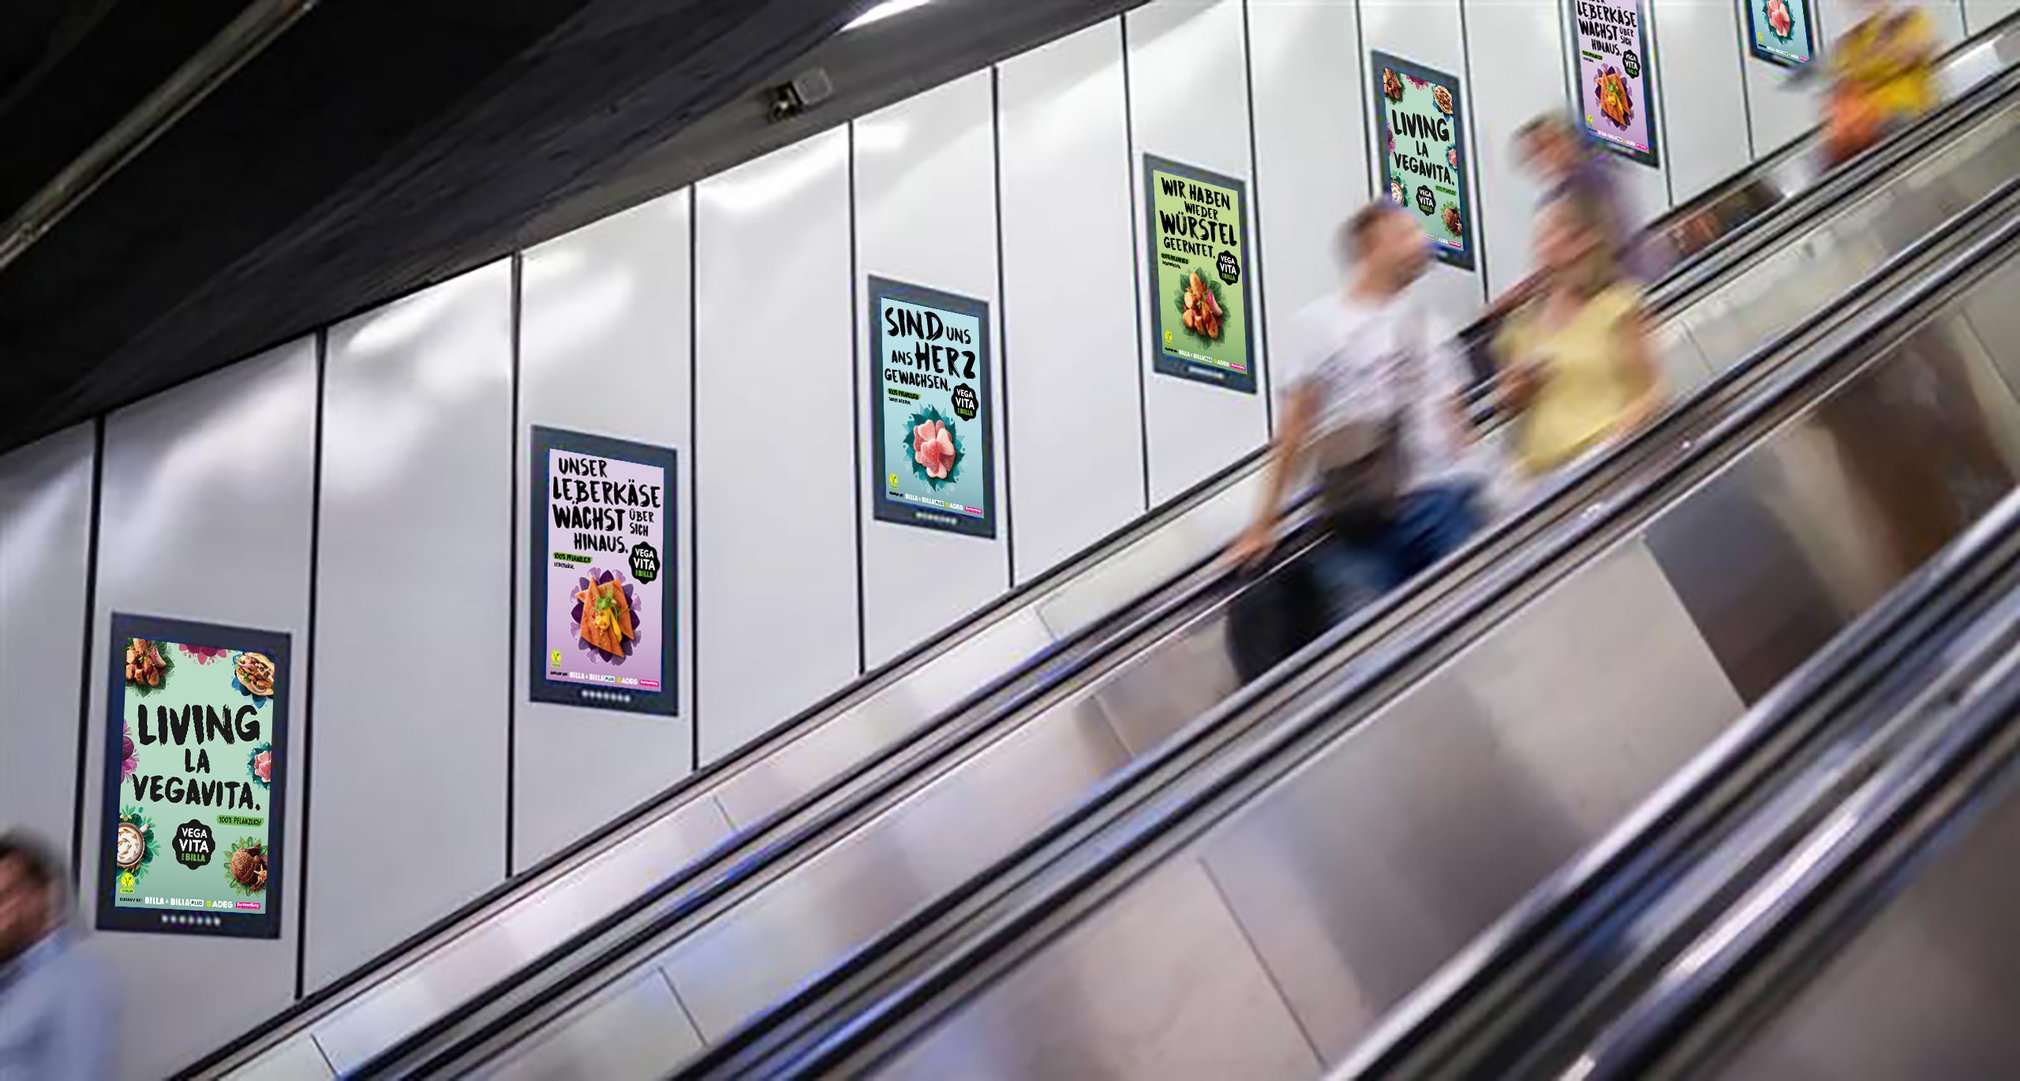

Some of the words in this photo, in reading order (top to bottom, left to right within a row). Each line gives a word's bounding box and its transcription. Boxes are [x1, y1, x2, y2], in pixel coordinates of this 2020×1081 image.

[1577, 0, 1637, 28] LEBERKÄSE
[1578, 18, 1618, 41] WÄCHST
[1591, 38, 1622, 57] HINAUS.
[1620, 36, 1632, 46] SICH
[1625, 60, 1638, 70] VITA
[1391, 109, 1450, 142] LIVING
[1415, 140, 1429, 158] LA
[1393, 151, 1455, 186] VEGAVITA.
[1160, 177, 1187, 200] WIR
[1189, 183, 1231, 211] HABEN
[1419, 195, 1434, 207] VITA
[1184, 201, 1219, 222] WIEDER
[1159, 210, 1238, 247] WÜRSTEL
[1163, 236, 1216, 260] GEERNTET.
[1219, 262, 1237, 275] VITA
[1220, 255, 1236, 265] VEGA
[884, 306, 944, 342] SIND
[946, 327, 972, 345] UNS
[891, 349, 913, 366] ANS
[914, 341, 976, 380] HERZ
[884, 368, 952, 392] GEWACHSEN.
[955, 396, 975, 410] VITA
[956, 388, 974, 399] VEGA
[558, 457, 608, 479] UNSER
[552, 475, 661, 509] LEBERKÄSE
[552, 500, 626, 532] WÄCHST
[629, 507, 655, 524] ÜBER
[629, 522, 649, 538] SICH
[573, 532, 629, 555] HINAUS.
[634, 548, 655, 559] VEGA
[633, 557, 656, 571] VITA
[137, 703, 261, 747] LIVING
[184, 748, 211, 774] LA
[132, 774, 261, 811] VEGAVITA.
[181, 827, 208, 839] VEGA
[179, 838, 209, 853] VITA
[185, 853, 206, 862] BILLA
[144, 896, 165, 905] BILLA
[170, 898, 190, 906] BILLA
[212, 900, 233, 909] ADEG
